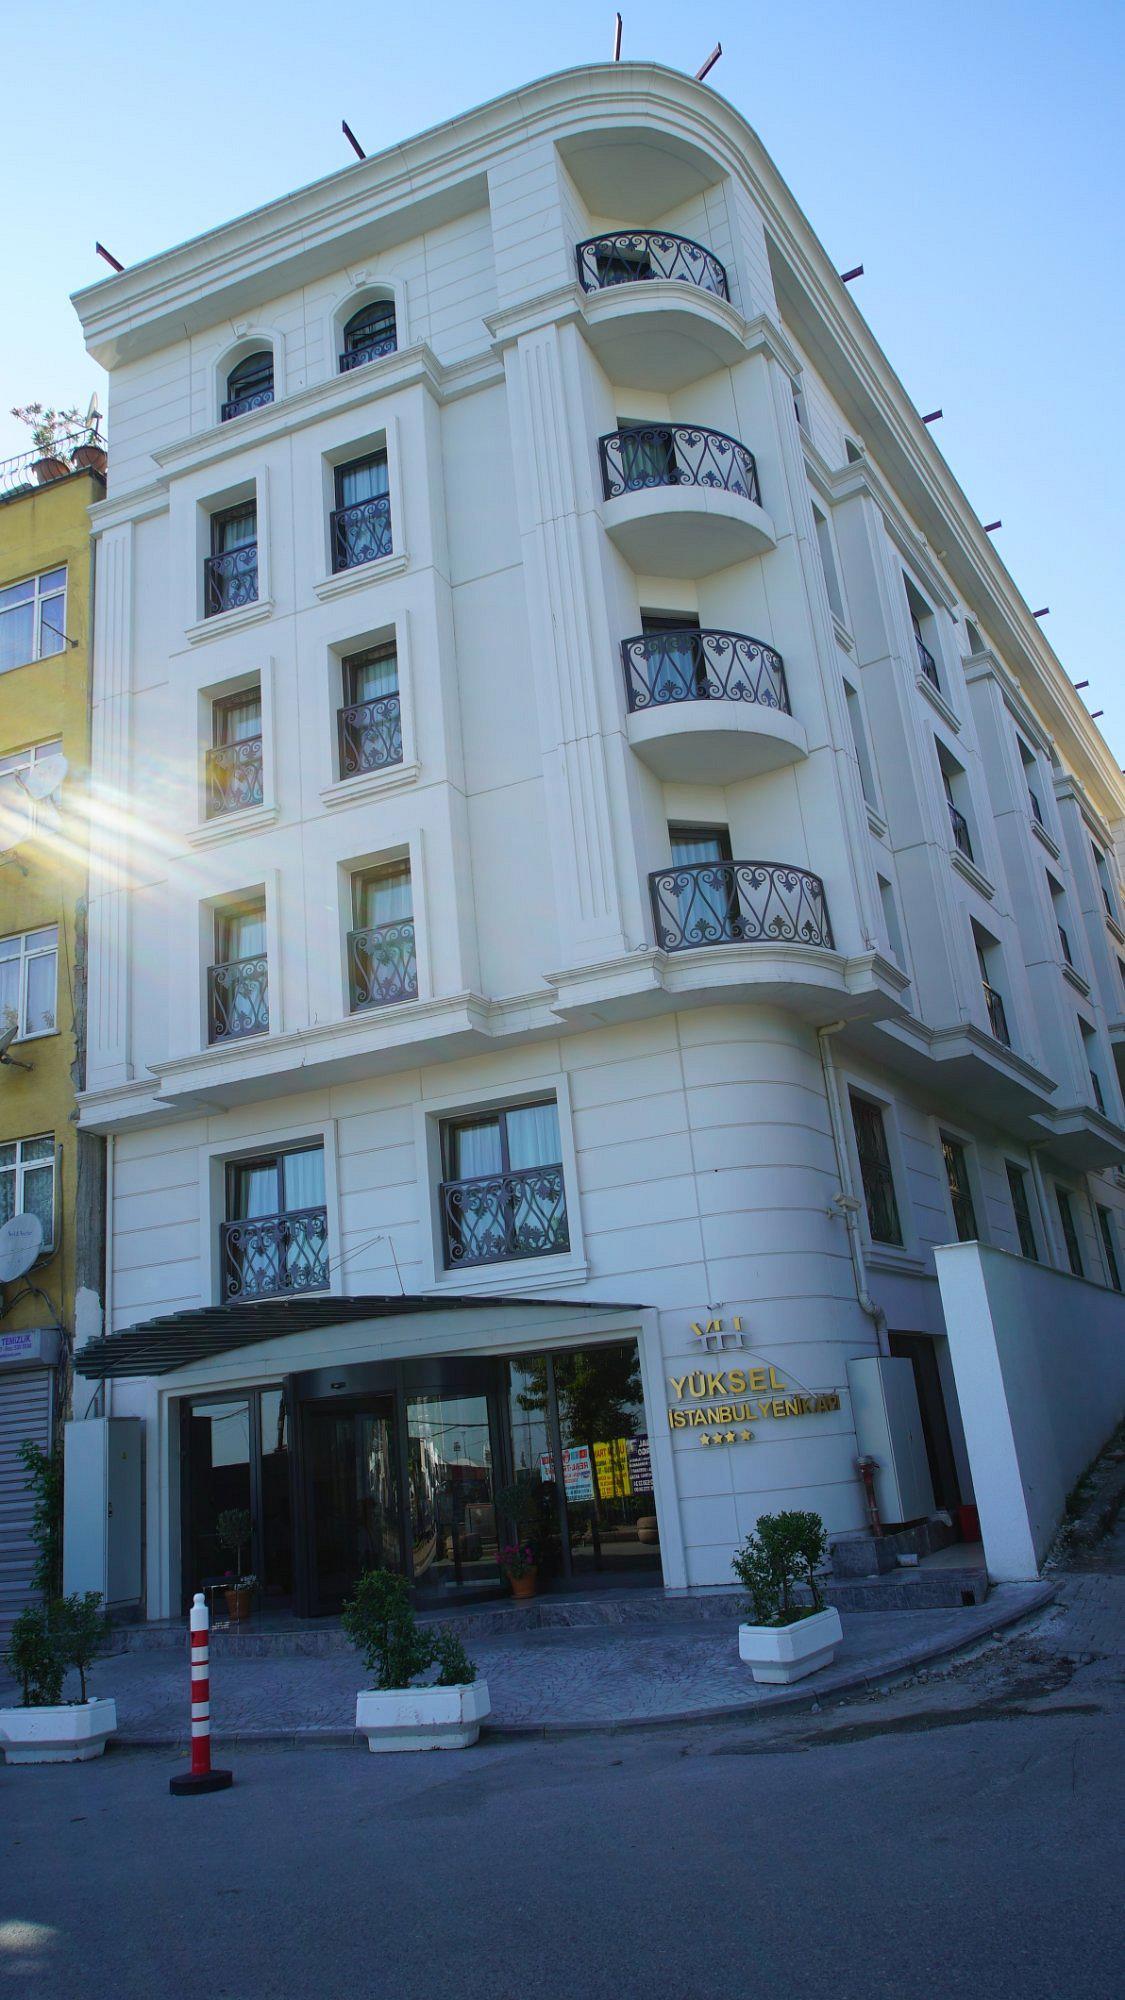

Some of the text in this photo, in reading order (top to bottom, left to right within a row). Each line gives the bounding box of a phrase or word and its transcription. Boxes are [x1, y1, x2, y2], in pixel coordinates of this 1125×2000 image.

[669, 1366, 787, 1400] YÜKSEL
[668, 1394, 841, 1429] İSTANBUL YENİKAPI
